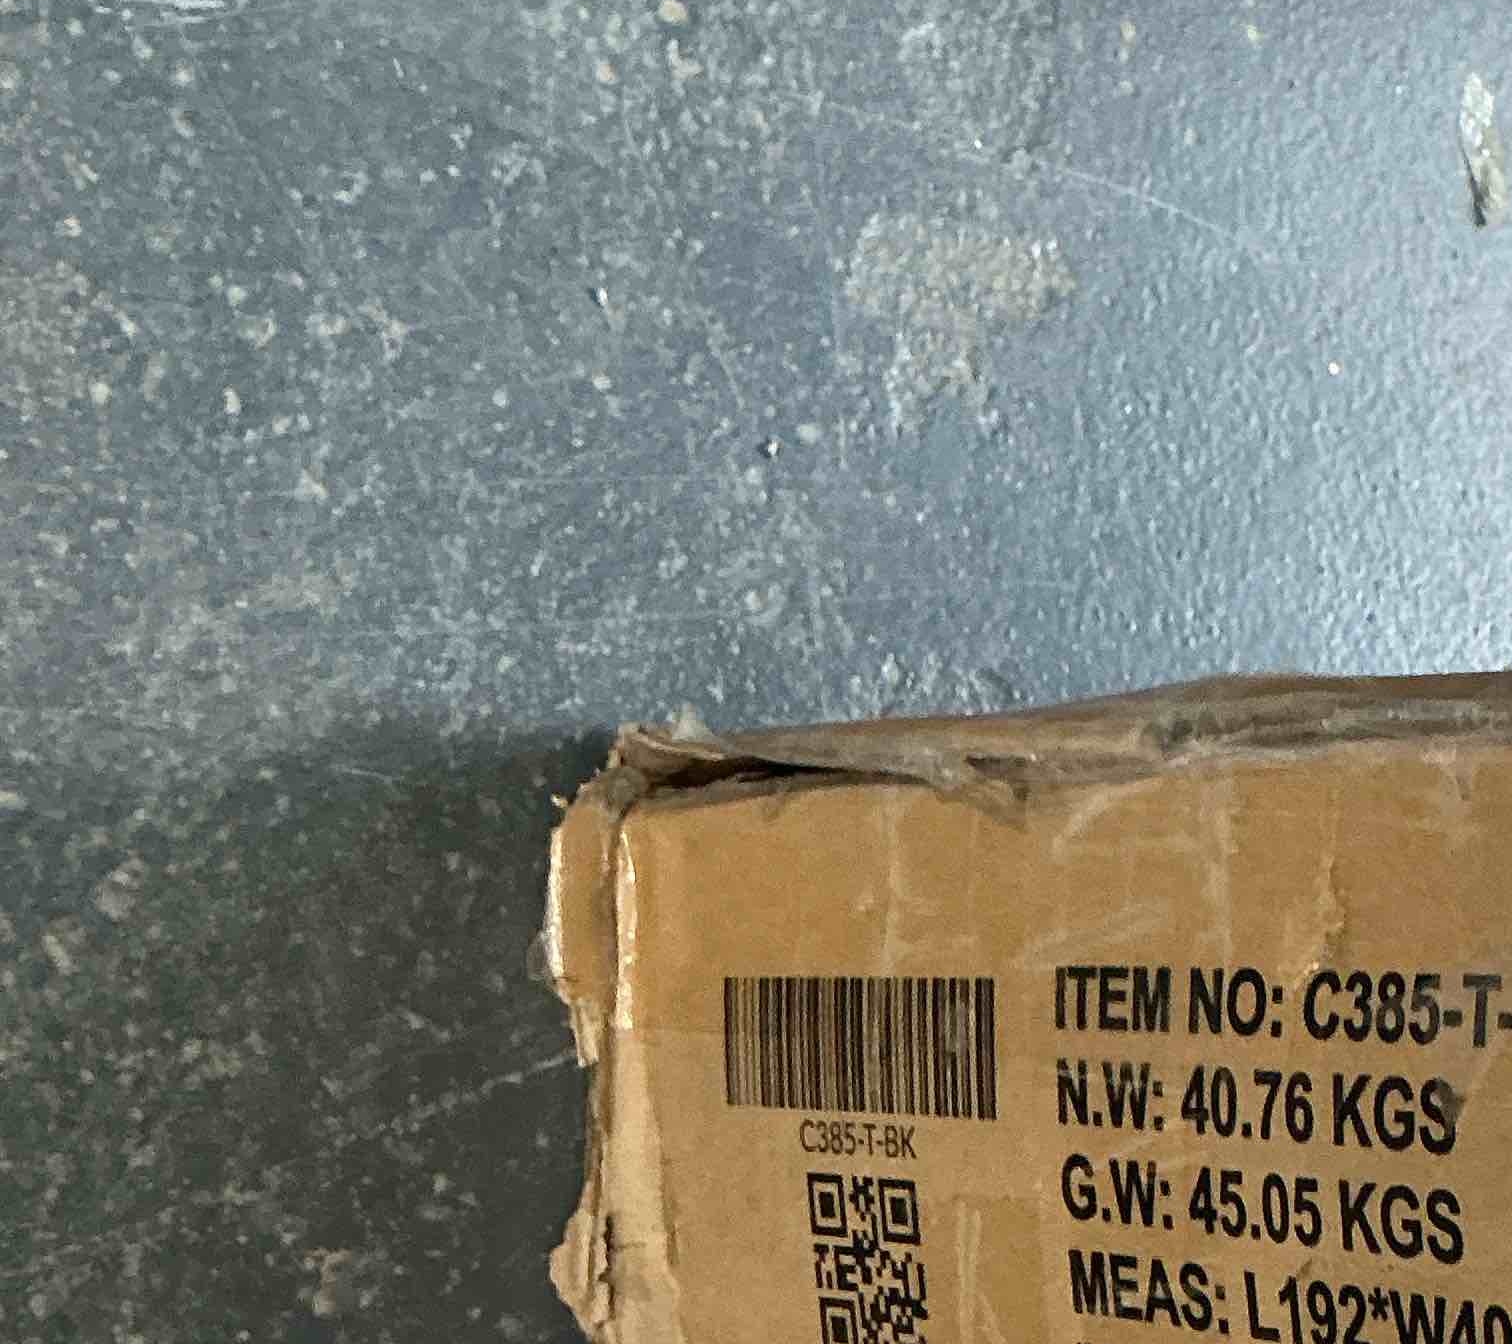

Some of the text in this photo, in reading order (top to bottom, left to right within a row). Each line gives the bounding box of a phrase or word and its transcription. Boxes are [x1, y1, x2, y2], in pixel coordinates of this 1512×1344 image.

[1055, 966, 1170, 1033] ITEM
[1188, 967, 1284, 1038] NO:
[801, 1119, 918, 1160] C385-T-BK
[1056, 1059, 1461, 1156] N.W: 40.76 KGS
[1061, 1153, 1464, 1265] G.W: 45.05 KGS
[1068, 1248, 1231, 1336] MEAS:
